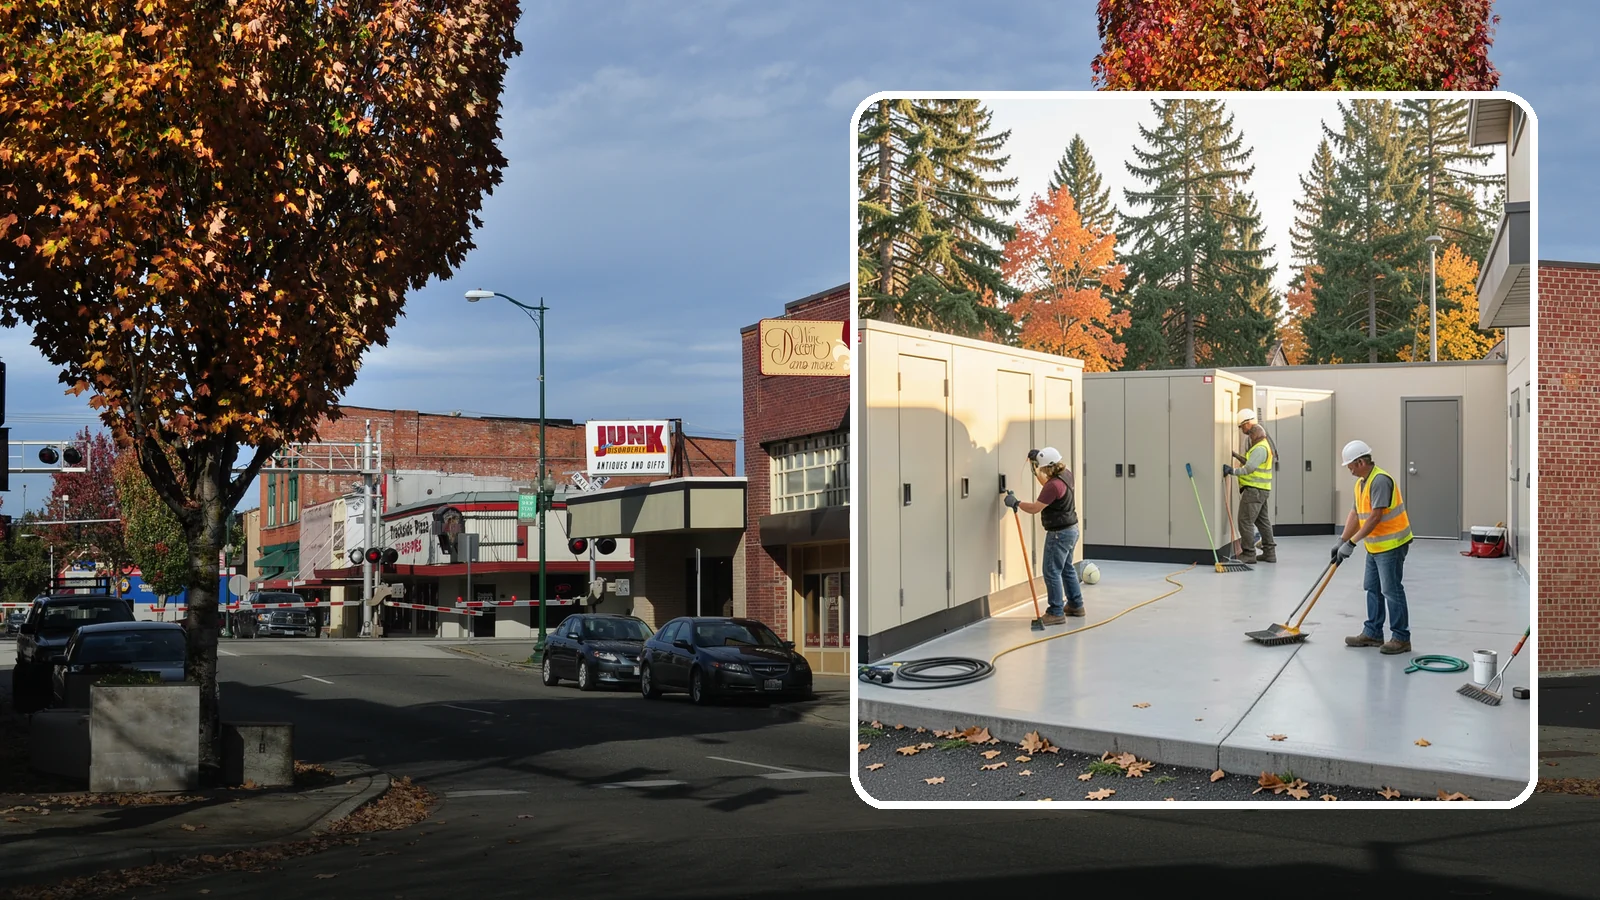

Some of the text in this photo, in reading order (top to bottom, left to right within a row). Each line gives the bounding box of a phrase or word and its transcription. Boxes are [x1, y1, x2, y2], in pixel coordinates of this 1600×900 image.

[595, 425, 666, 457] JUNK
[608, 446, 645, 454] DISORDERLY
[597, 461, 665, 470] ANTIQUES AND GIFTS
[390, 520, 429, 539] Trackside Pizza
